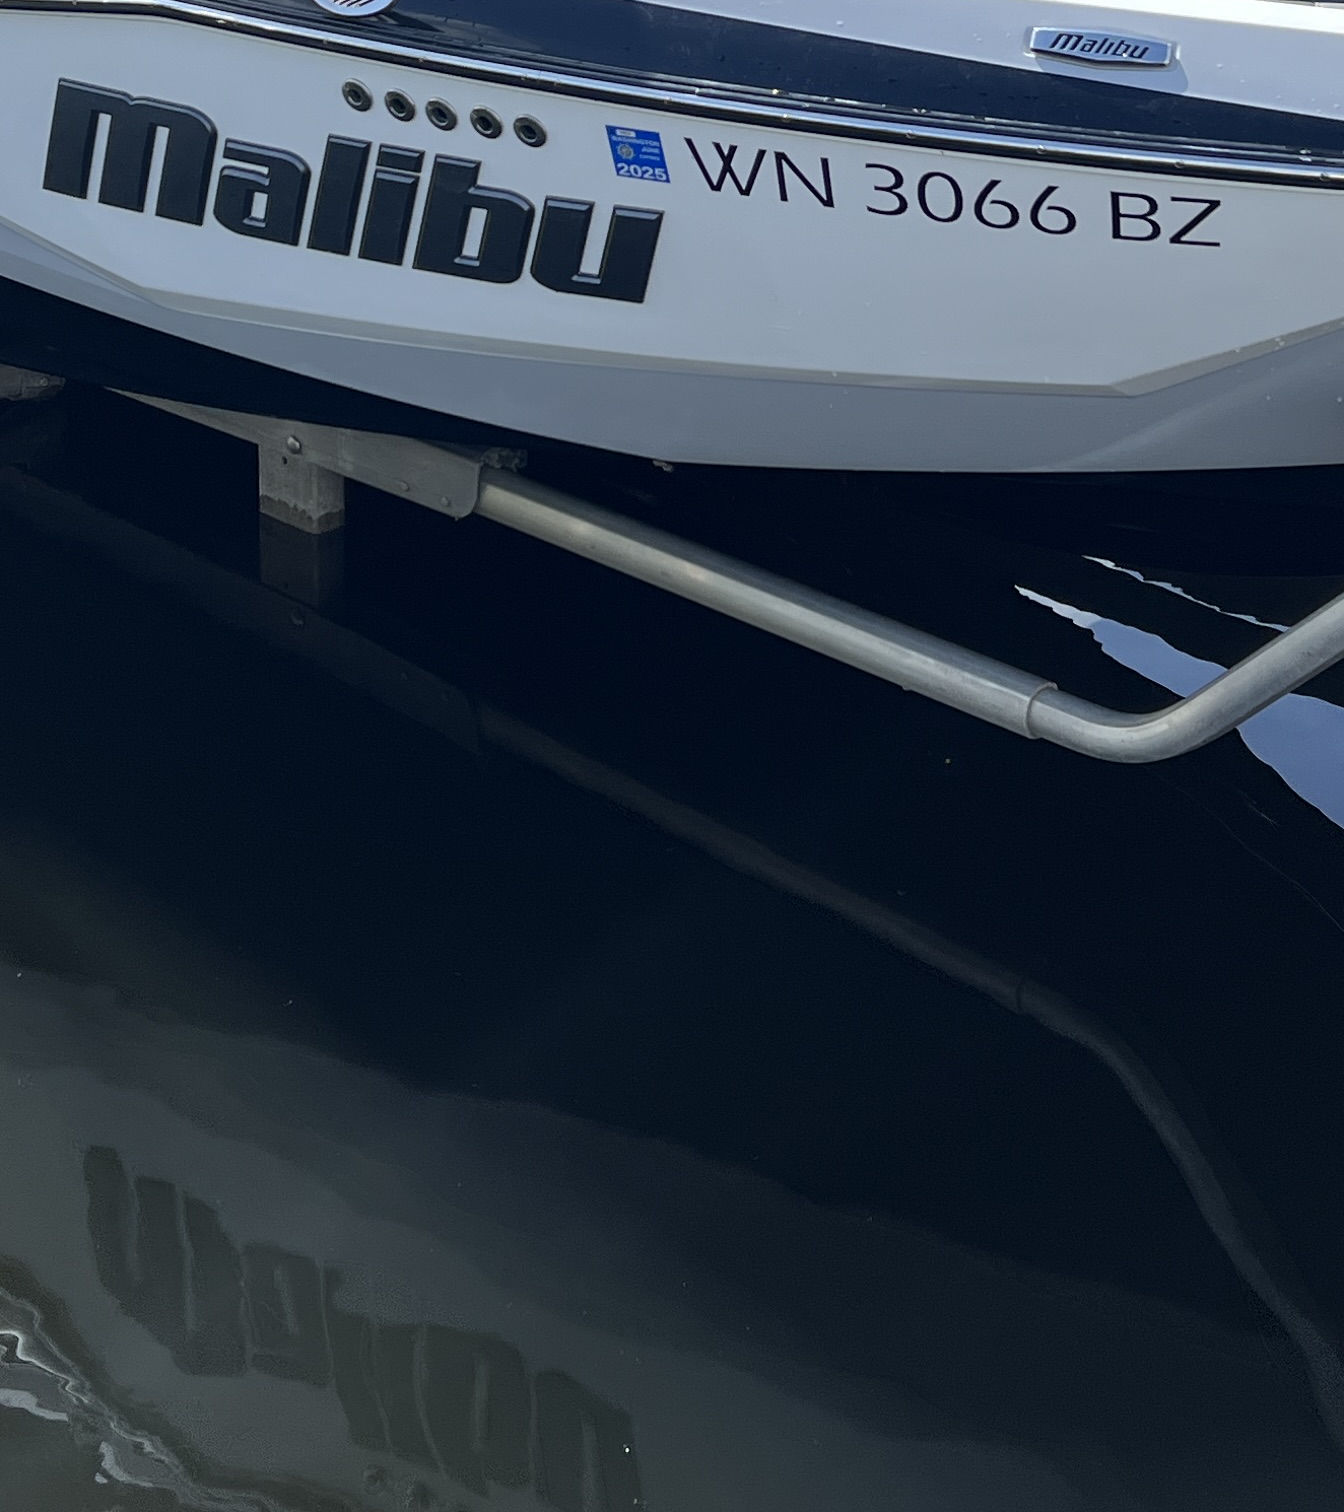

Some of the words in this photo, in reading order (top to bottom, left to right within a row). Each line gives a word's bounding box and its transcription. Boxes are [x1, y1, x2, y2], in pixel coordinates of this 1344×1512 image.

[1049, 32, 1150, 59] Malibu
[42, 77, 665, 304] Malibu
[617, 162, 667, 181] 2025
[683, 136, 836, 210] WN
[865, 162, 1078, 237] 3066
[1110, 190, 1222, 248] BZ
